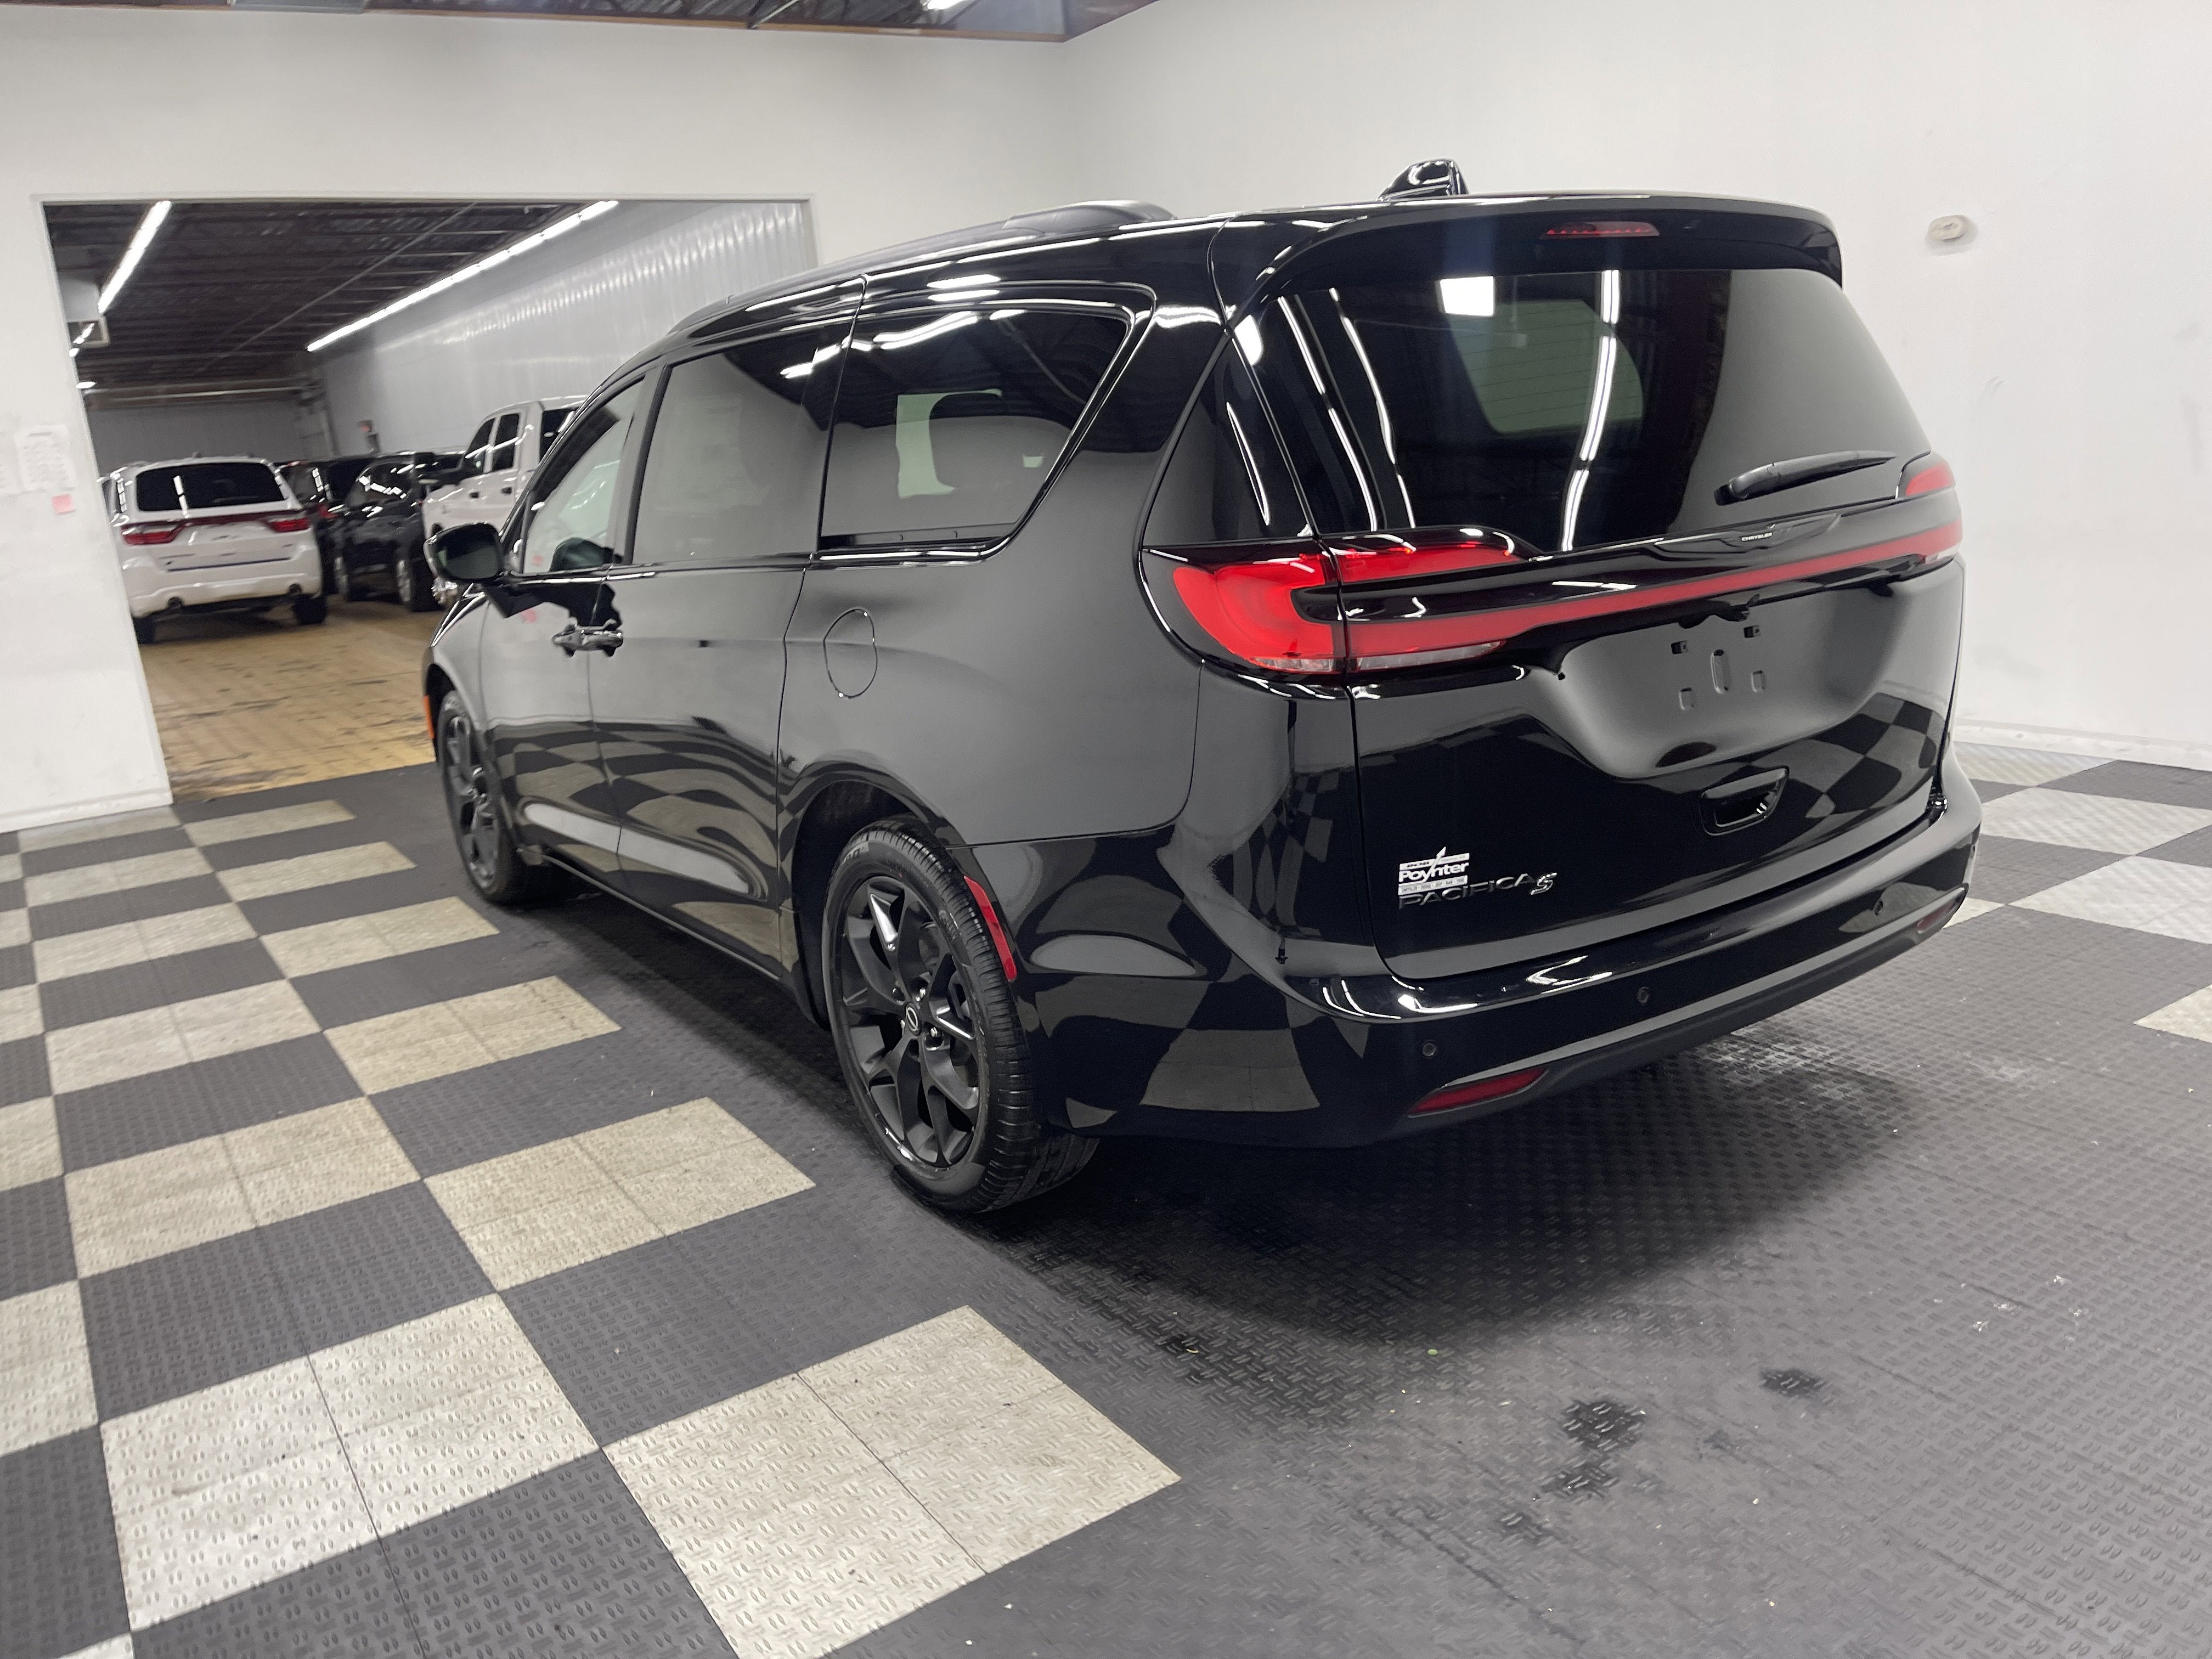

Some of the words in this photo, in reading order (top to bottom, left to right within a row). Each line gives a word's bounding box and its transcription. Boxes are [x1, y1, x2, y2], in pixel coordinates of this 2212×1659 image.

[1741, 532, 1773, 541] CHRYSLER
[1399, 862, 1469, 883] Poynter
[1399, 873, 1534, 909] PACIFICA
[1529, 872, 1557, 895] S
